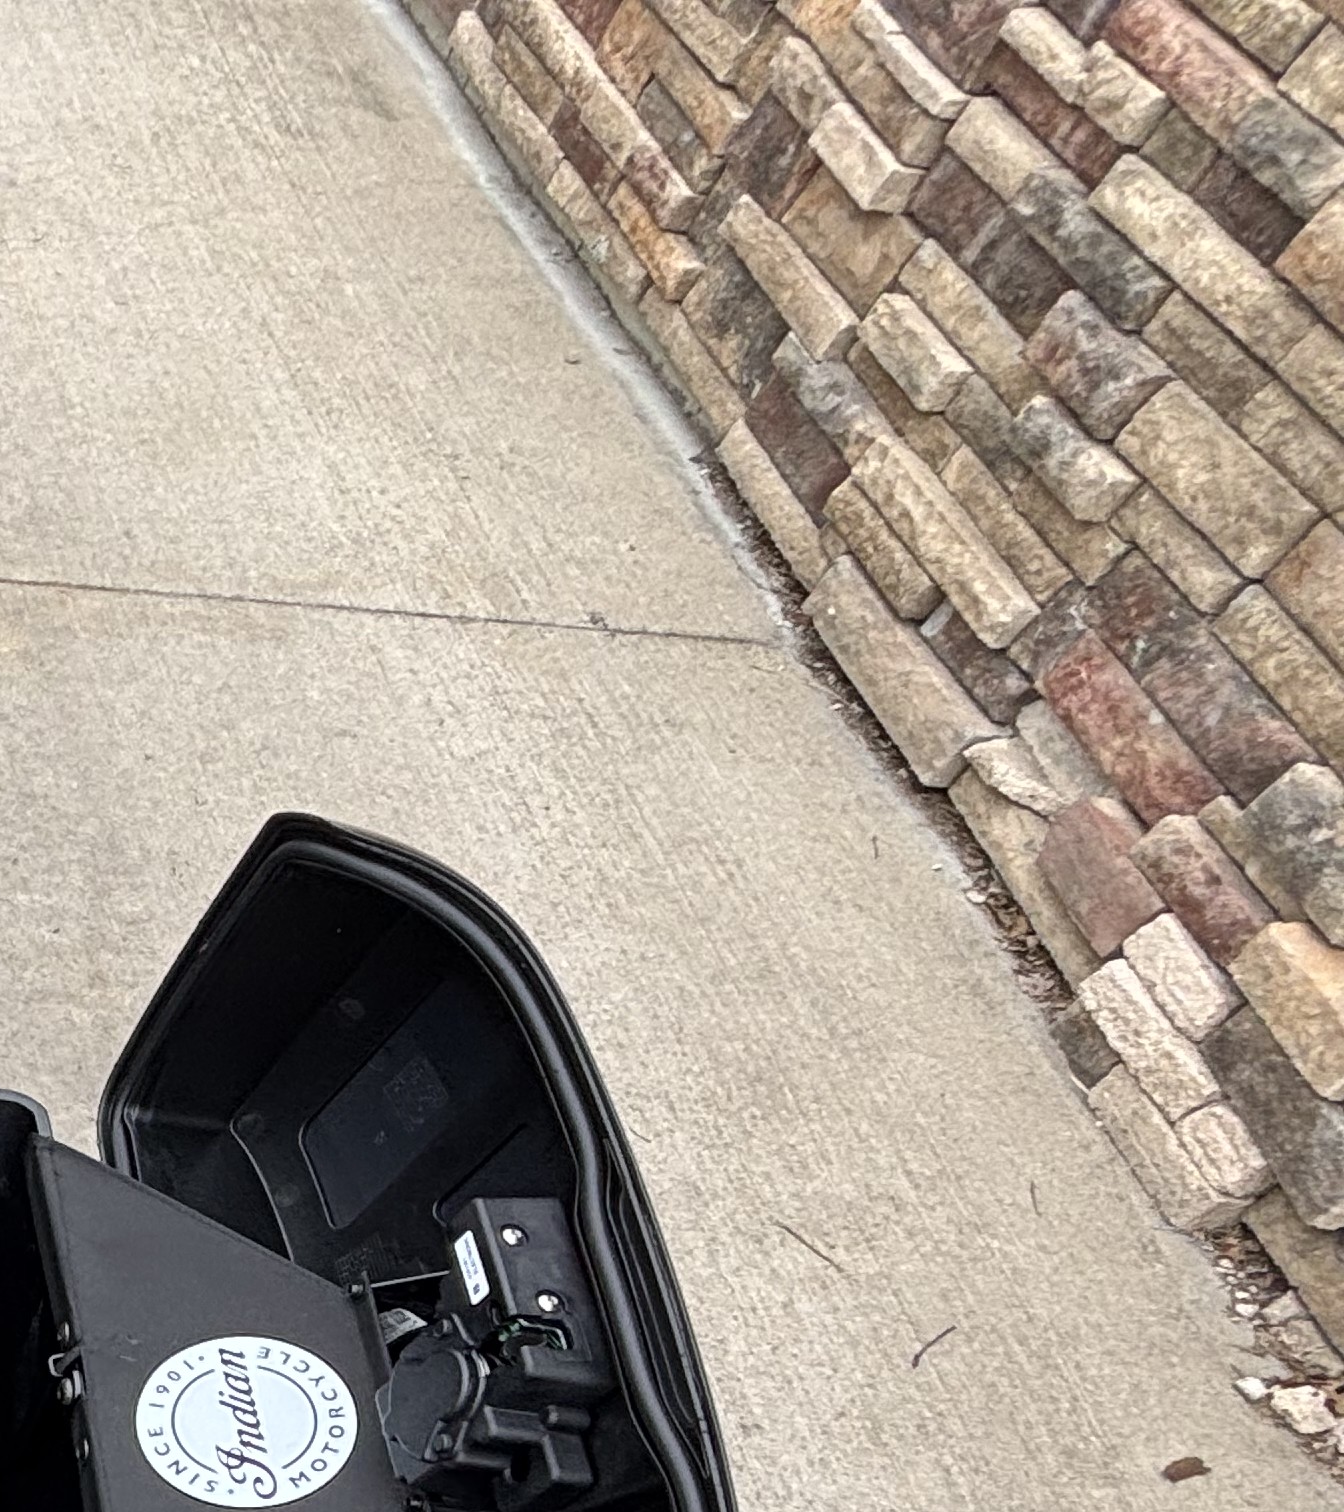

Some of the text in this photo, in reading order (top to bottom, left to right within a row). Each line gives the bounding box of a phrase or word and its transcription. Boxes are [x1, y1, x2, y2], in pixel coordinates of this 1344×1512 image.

[147, 1359, 219, 1493] SINCE 1901
[215, 1347, 277, 1499] Indian
[256, 1346, 346, 1488] MOTORCYCLE
